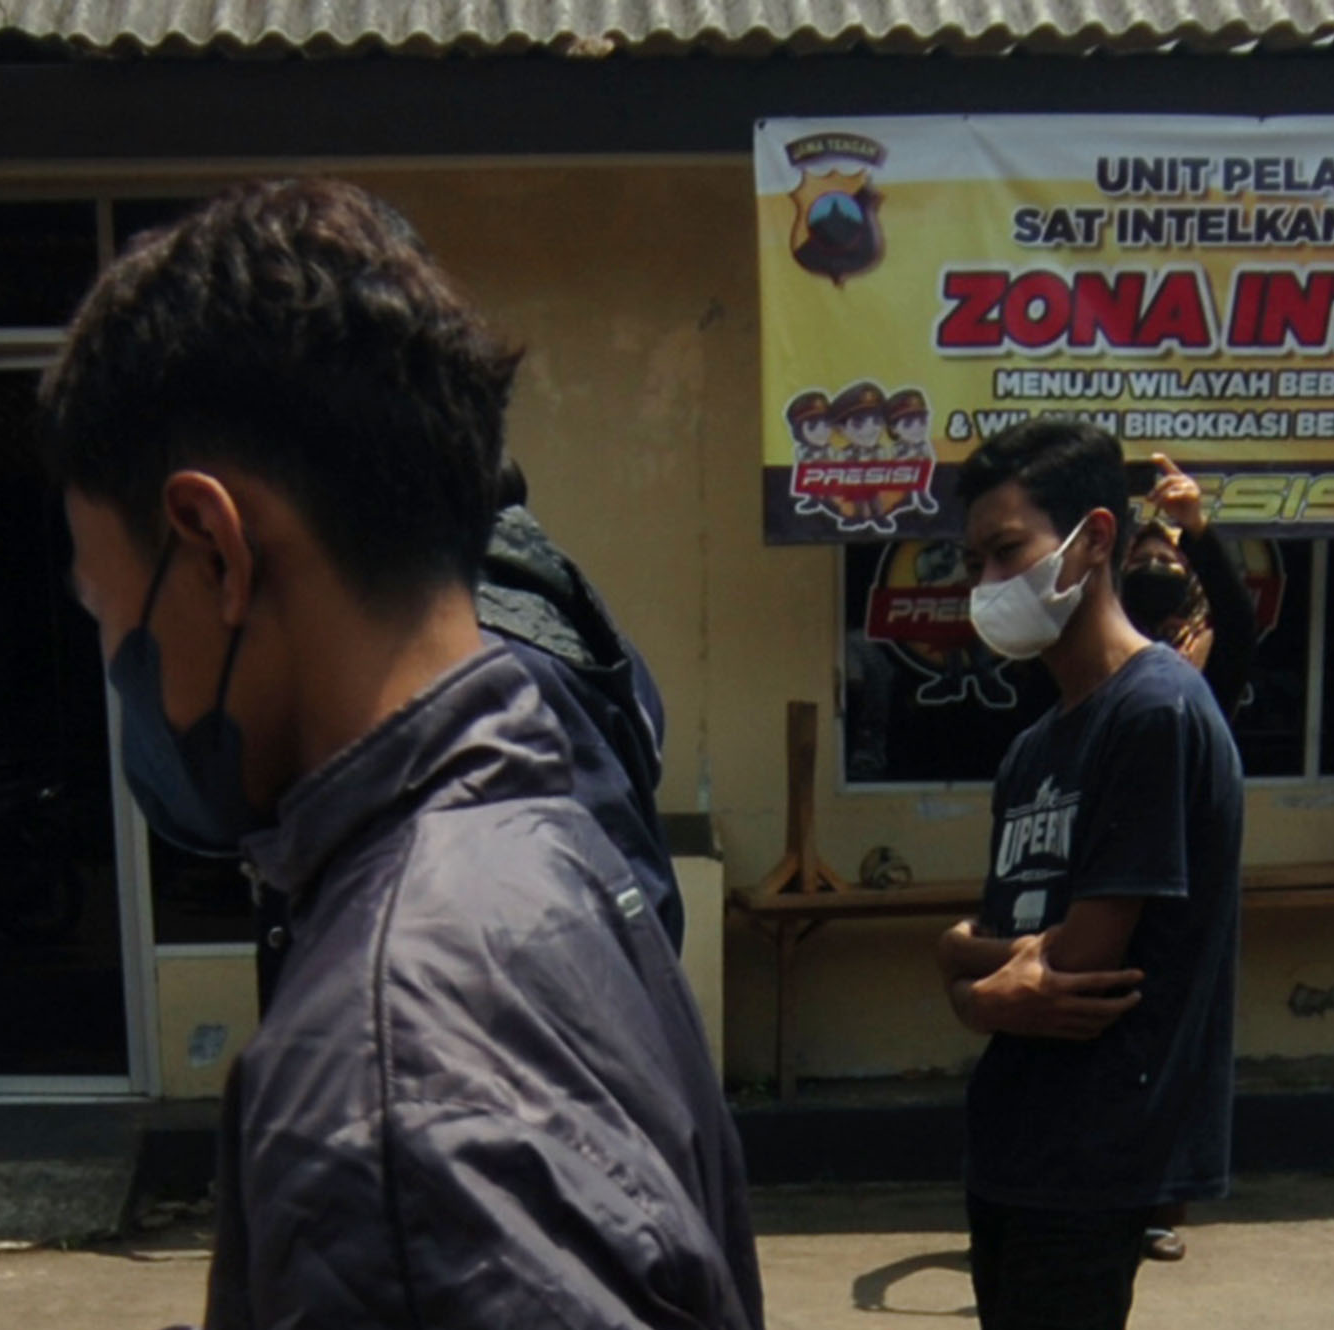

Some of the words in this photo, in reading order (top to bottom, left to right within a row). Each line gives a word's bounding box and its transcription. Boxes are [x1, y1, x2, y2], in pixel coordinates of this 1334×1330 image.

[1096, 156, 1210, 193] UNIT
[1013, 208, 1104, 244] SAT
[936, 269, 1212, 349] ZONA
[995, 370, 1122, 398] MENUJU
[1128, 370, 1270, 398] WILAYAH
[948, 412, 968, 440] &
[1124, 411, 1288, 438] BIROKRASI
[801, 465, 922, 487] PRESISI
